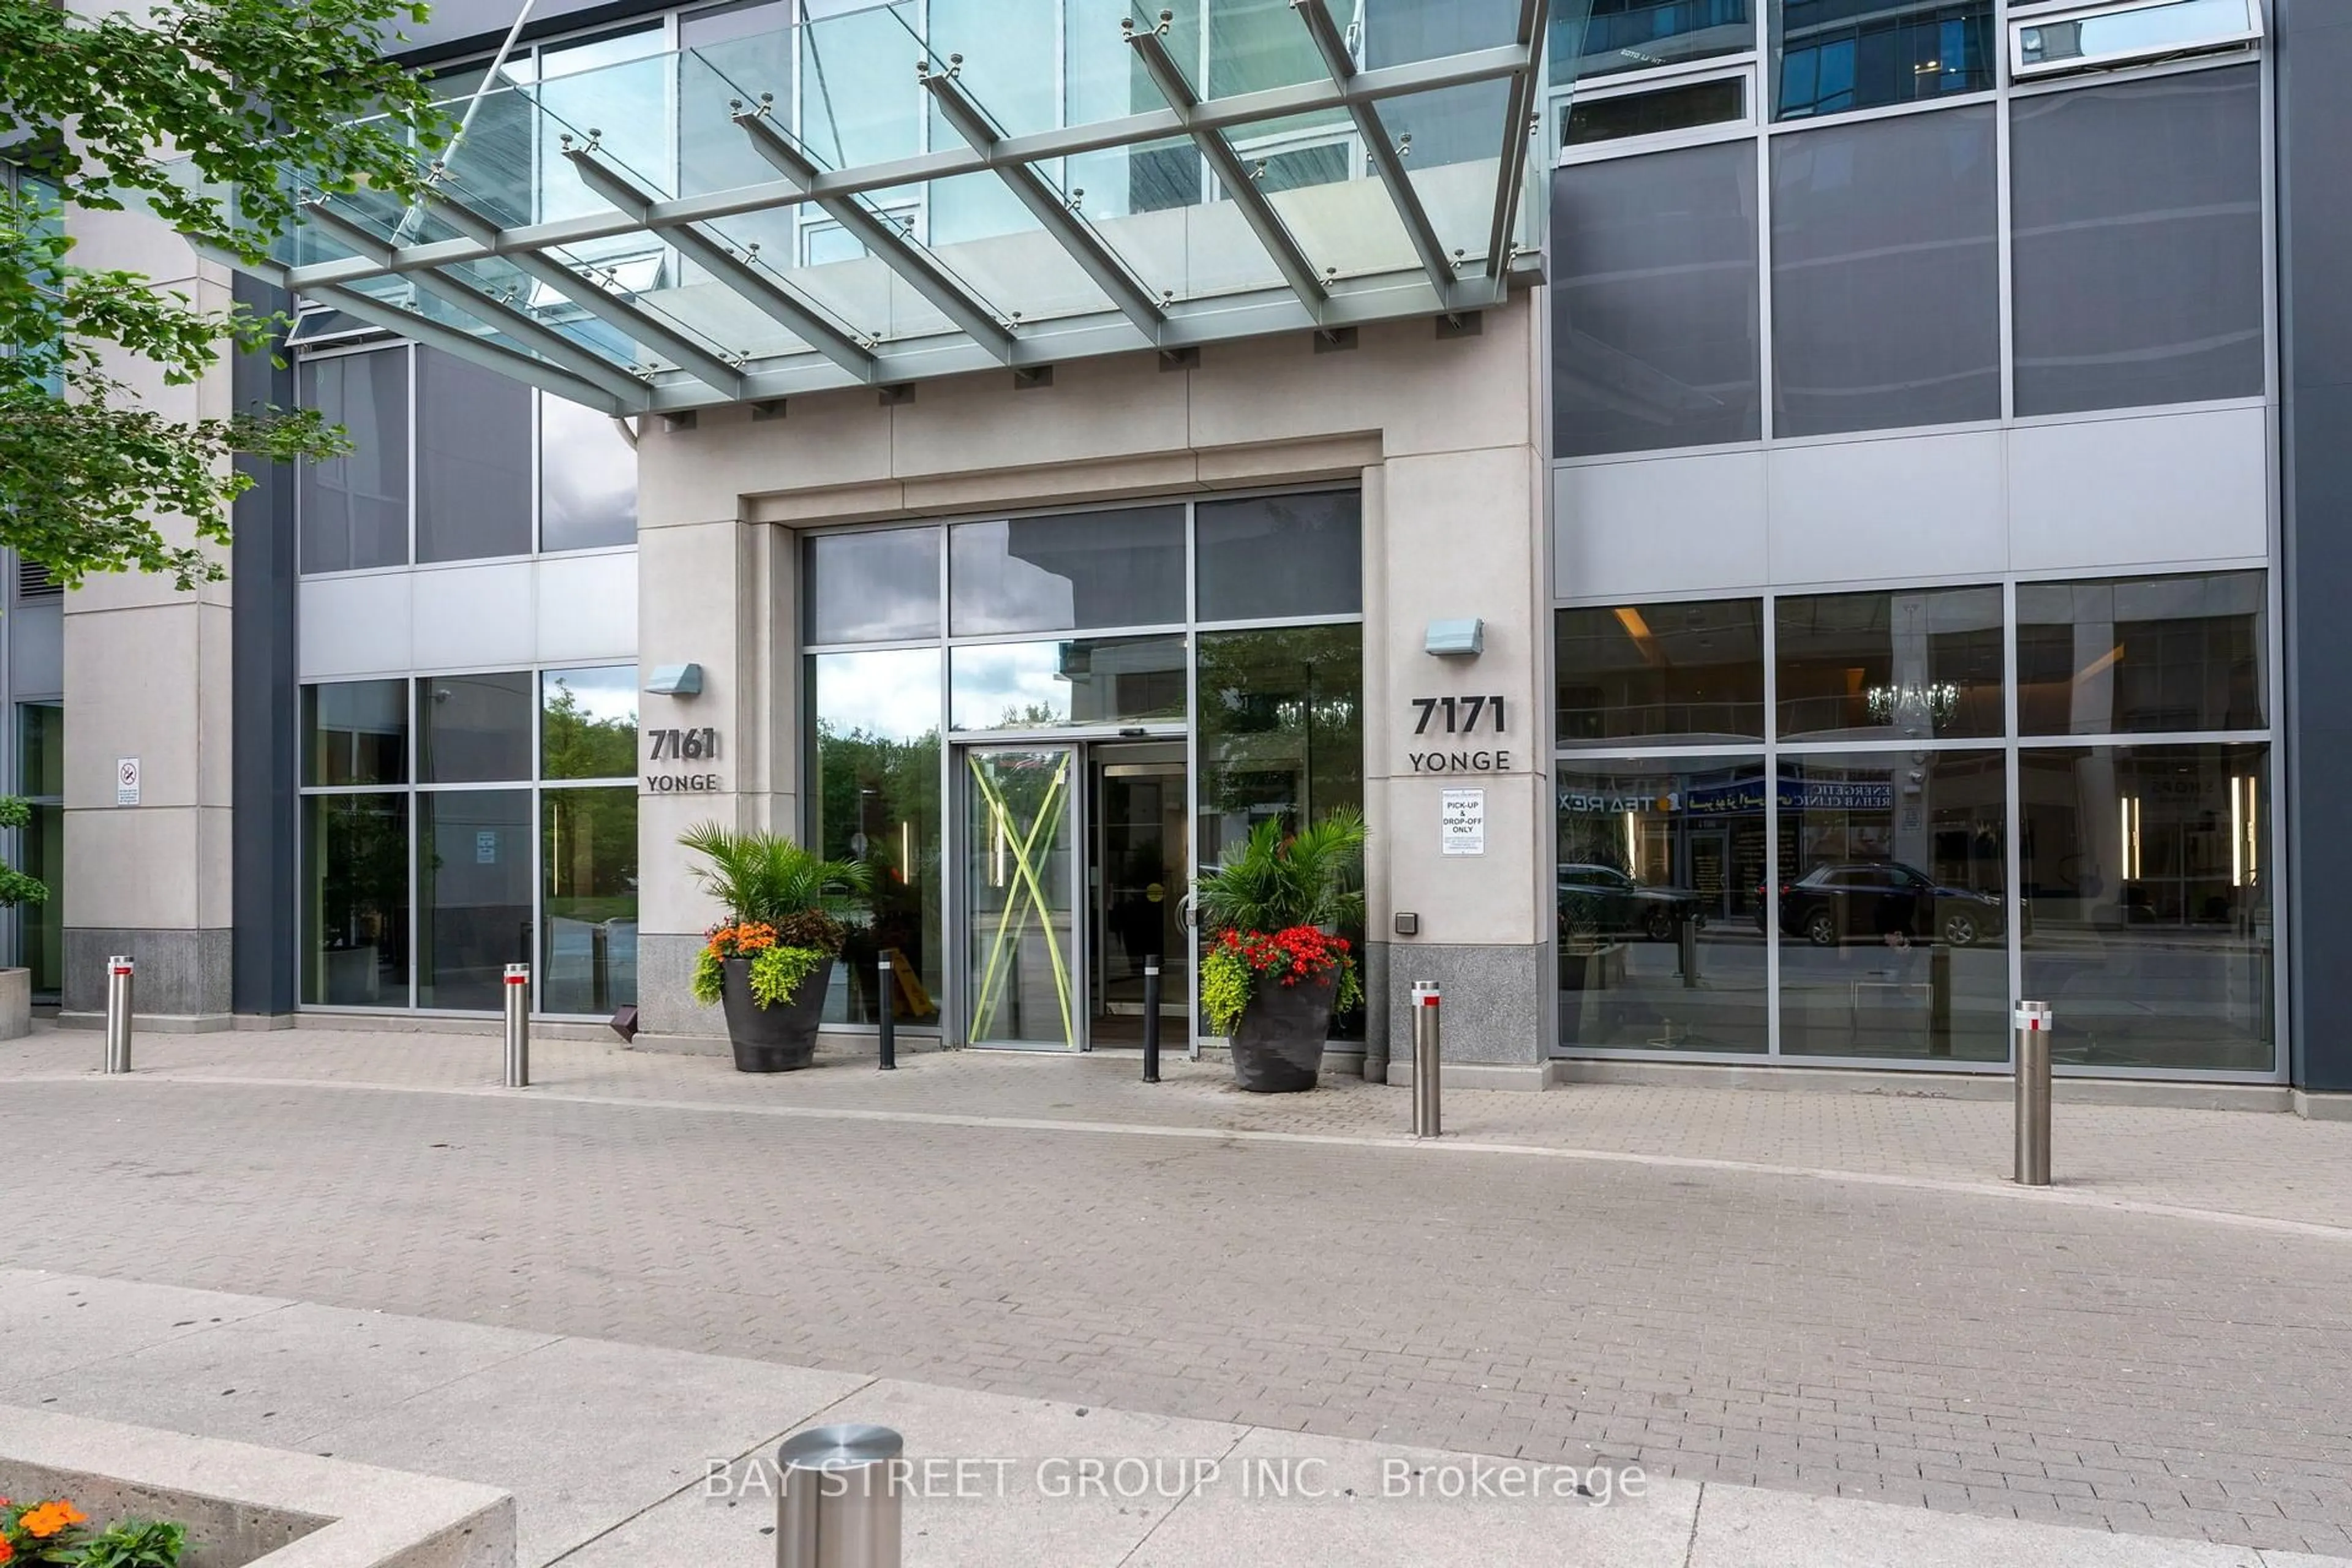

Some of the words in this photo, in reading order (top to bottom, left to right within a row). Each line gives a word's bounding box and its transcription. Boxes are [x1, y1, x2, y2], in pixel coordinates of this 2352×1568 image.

[1412, 696, 1504, 734] 7171
[648, 727, 715, 760] 7161
[1409, 751, 1510, 772] YONGE
[647, 774, 717, 791] YONGE
